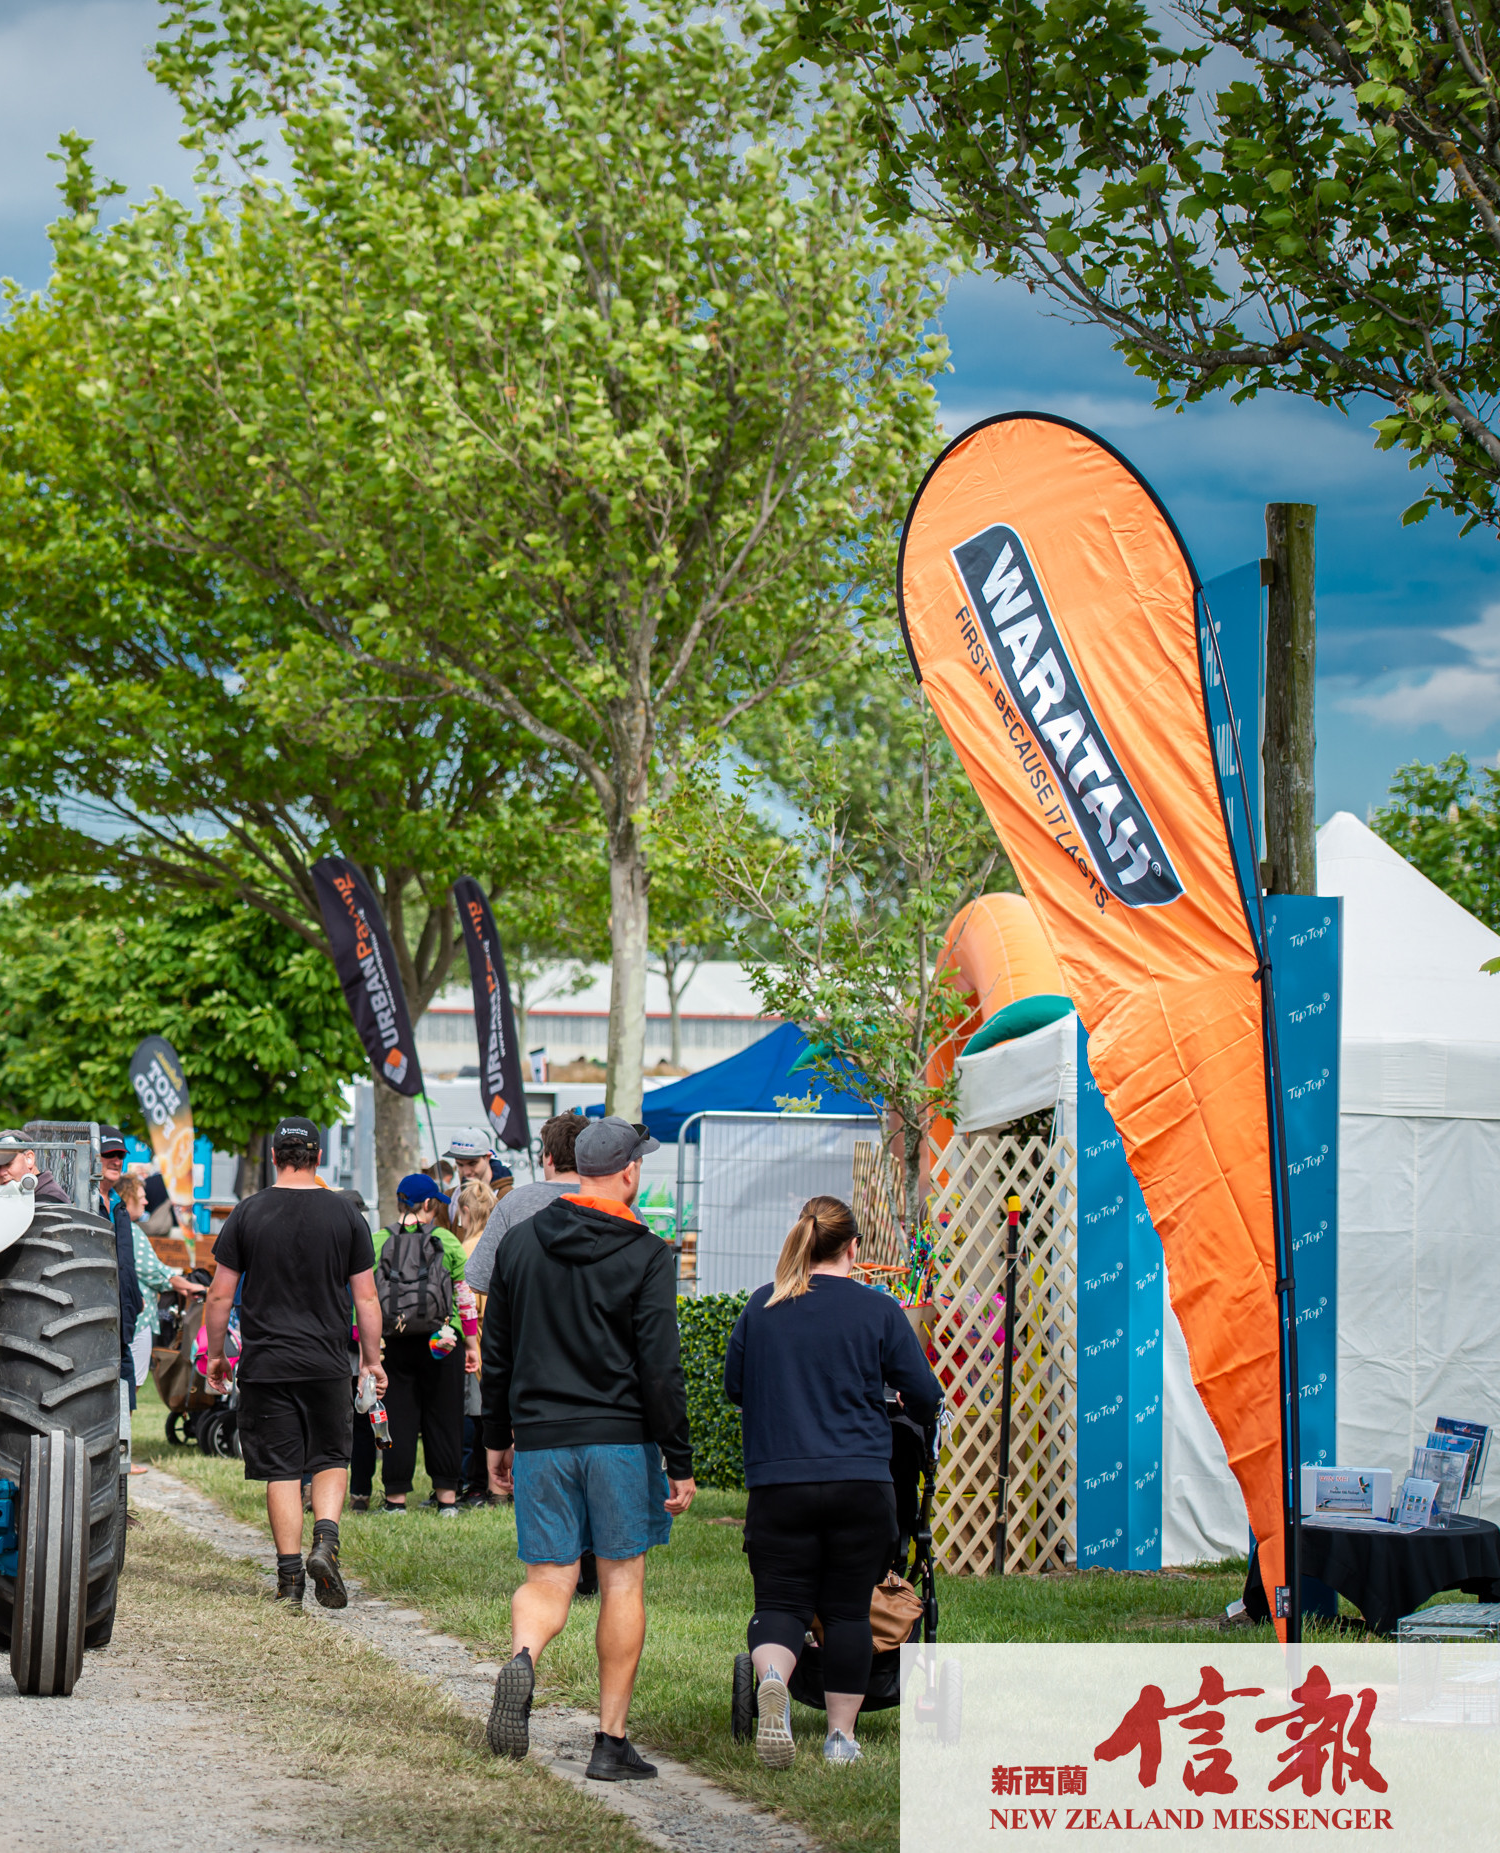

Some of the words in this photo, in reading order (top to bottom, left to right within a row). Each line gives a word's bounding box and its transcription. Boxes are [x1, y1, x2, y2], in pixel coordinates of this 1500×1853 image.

[955, 605, 992, 679] FIRST
[993, 688, 1055, 806] BECAUSE
[1044, 802, 1067, 826] IT
[1055, 829, 1110, 916] LASTS.
